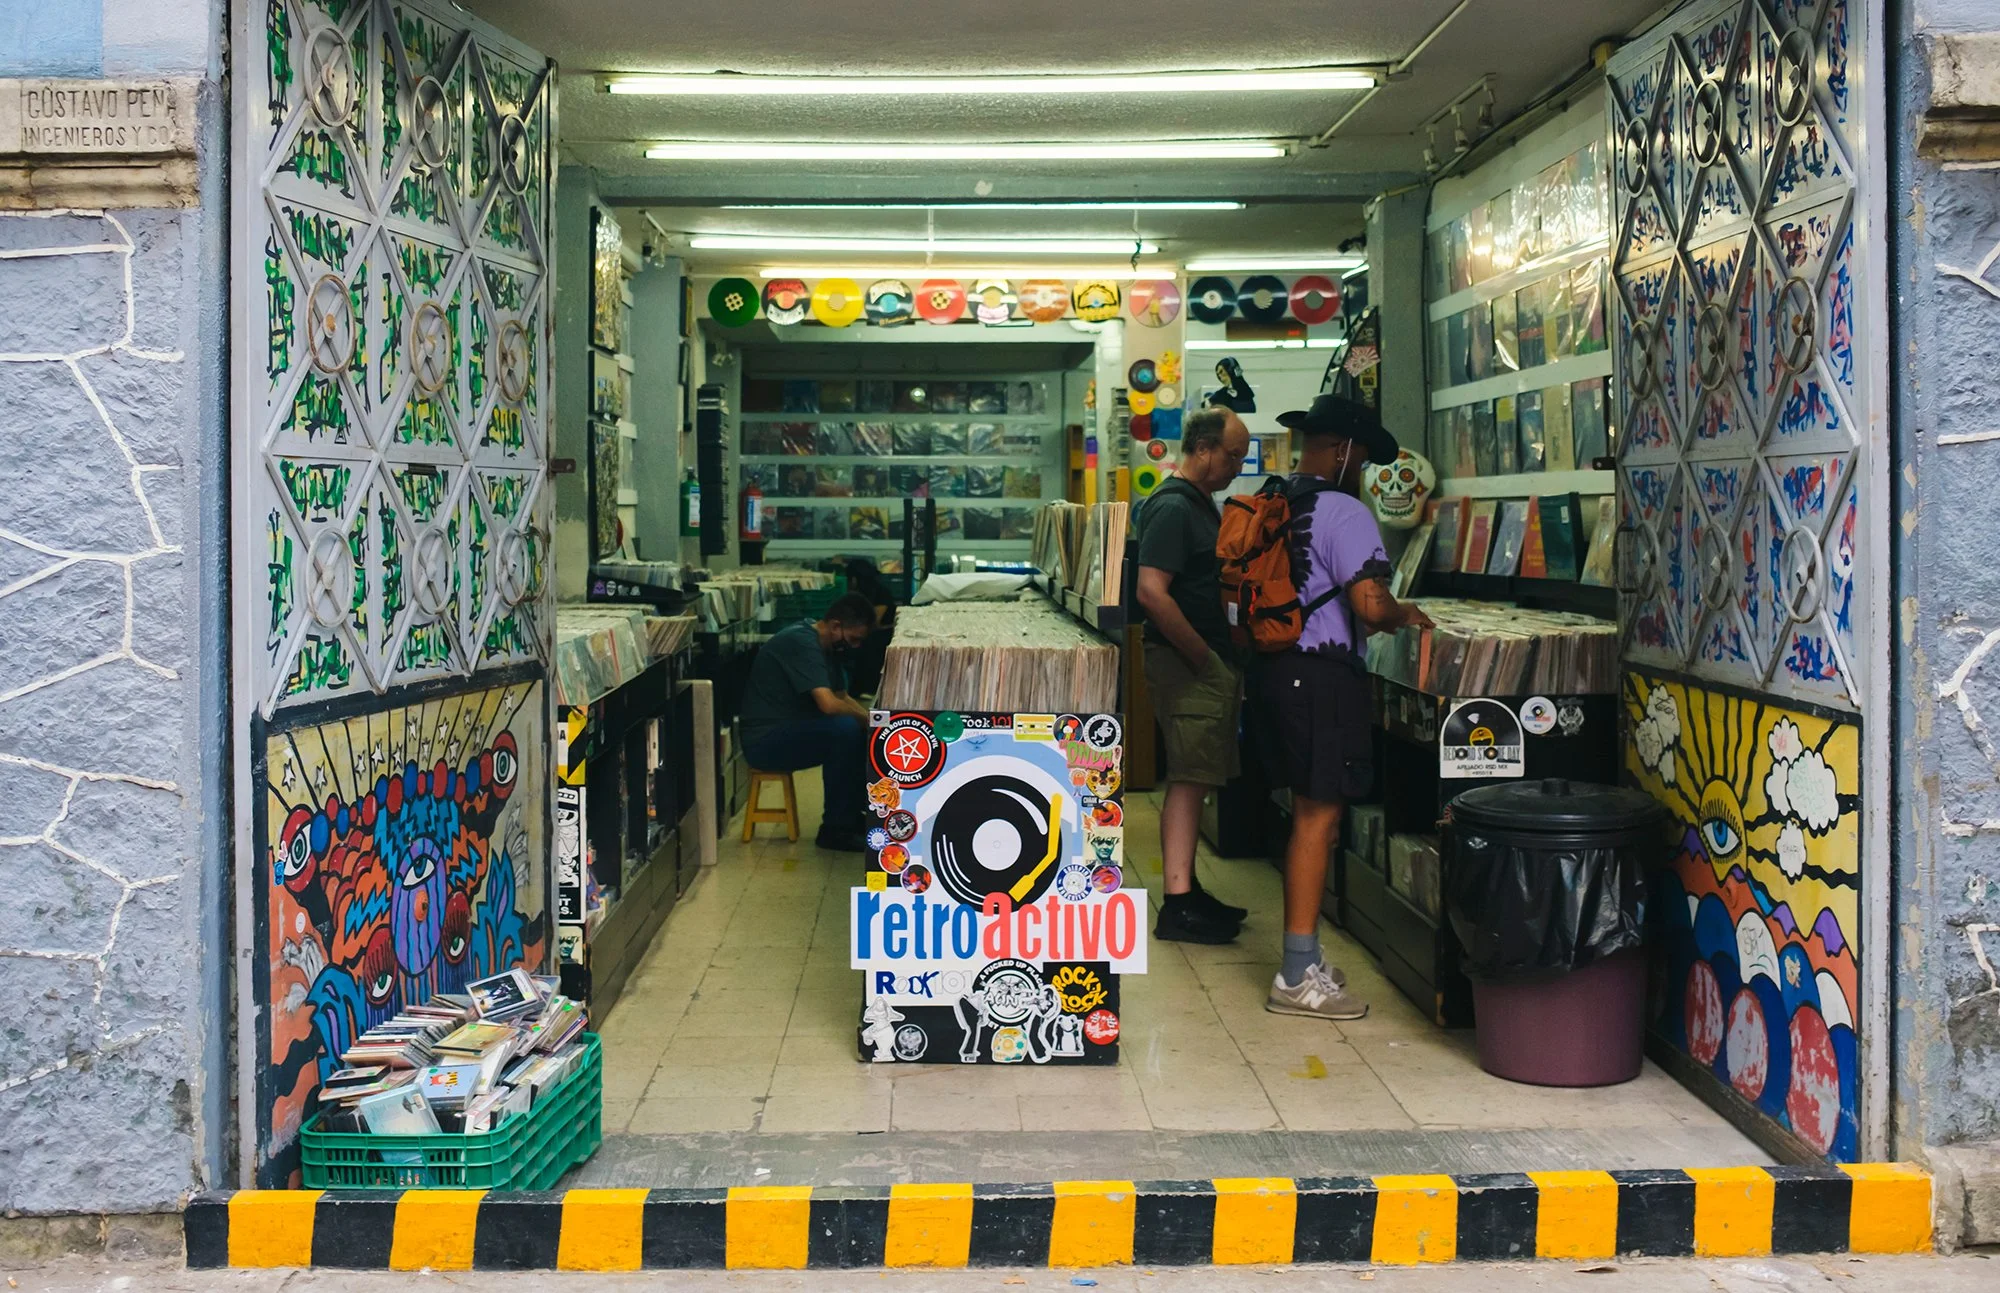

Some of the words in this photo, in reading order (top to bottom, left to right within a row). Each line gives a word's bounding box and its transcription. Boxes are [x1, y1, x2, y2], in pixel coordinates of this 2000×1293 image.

[23, 126, 126, 147] INGENIEROS
[131, 126, 142, 146] Y
[991, 716, 1012, 728] 101
[879, 727, 890, 740] THE
[890, 719, 911, 730] ROUTE
[911, 719, 921, 727] OF
[921, 724, 931, 736] ALL
[929, 733, 939, 749] EVIL
[888, 770, 922, 782] RAUNCH
[980, 973, 986, 981] A
[984, 960, 1014, 975] FUCKED
[1015, 960, 1027, 969] UP
